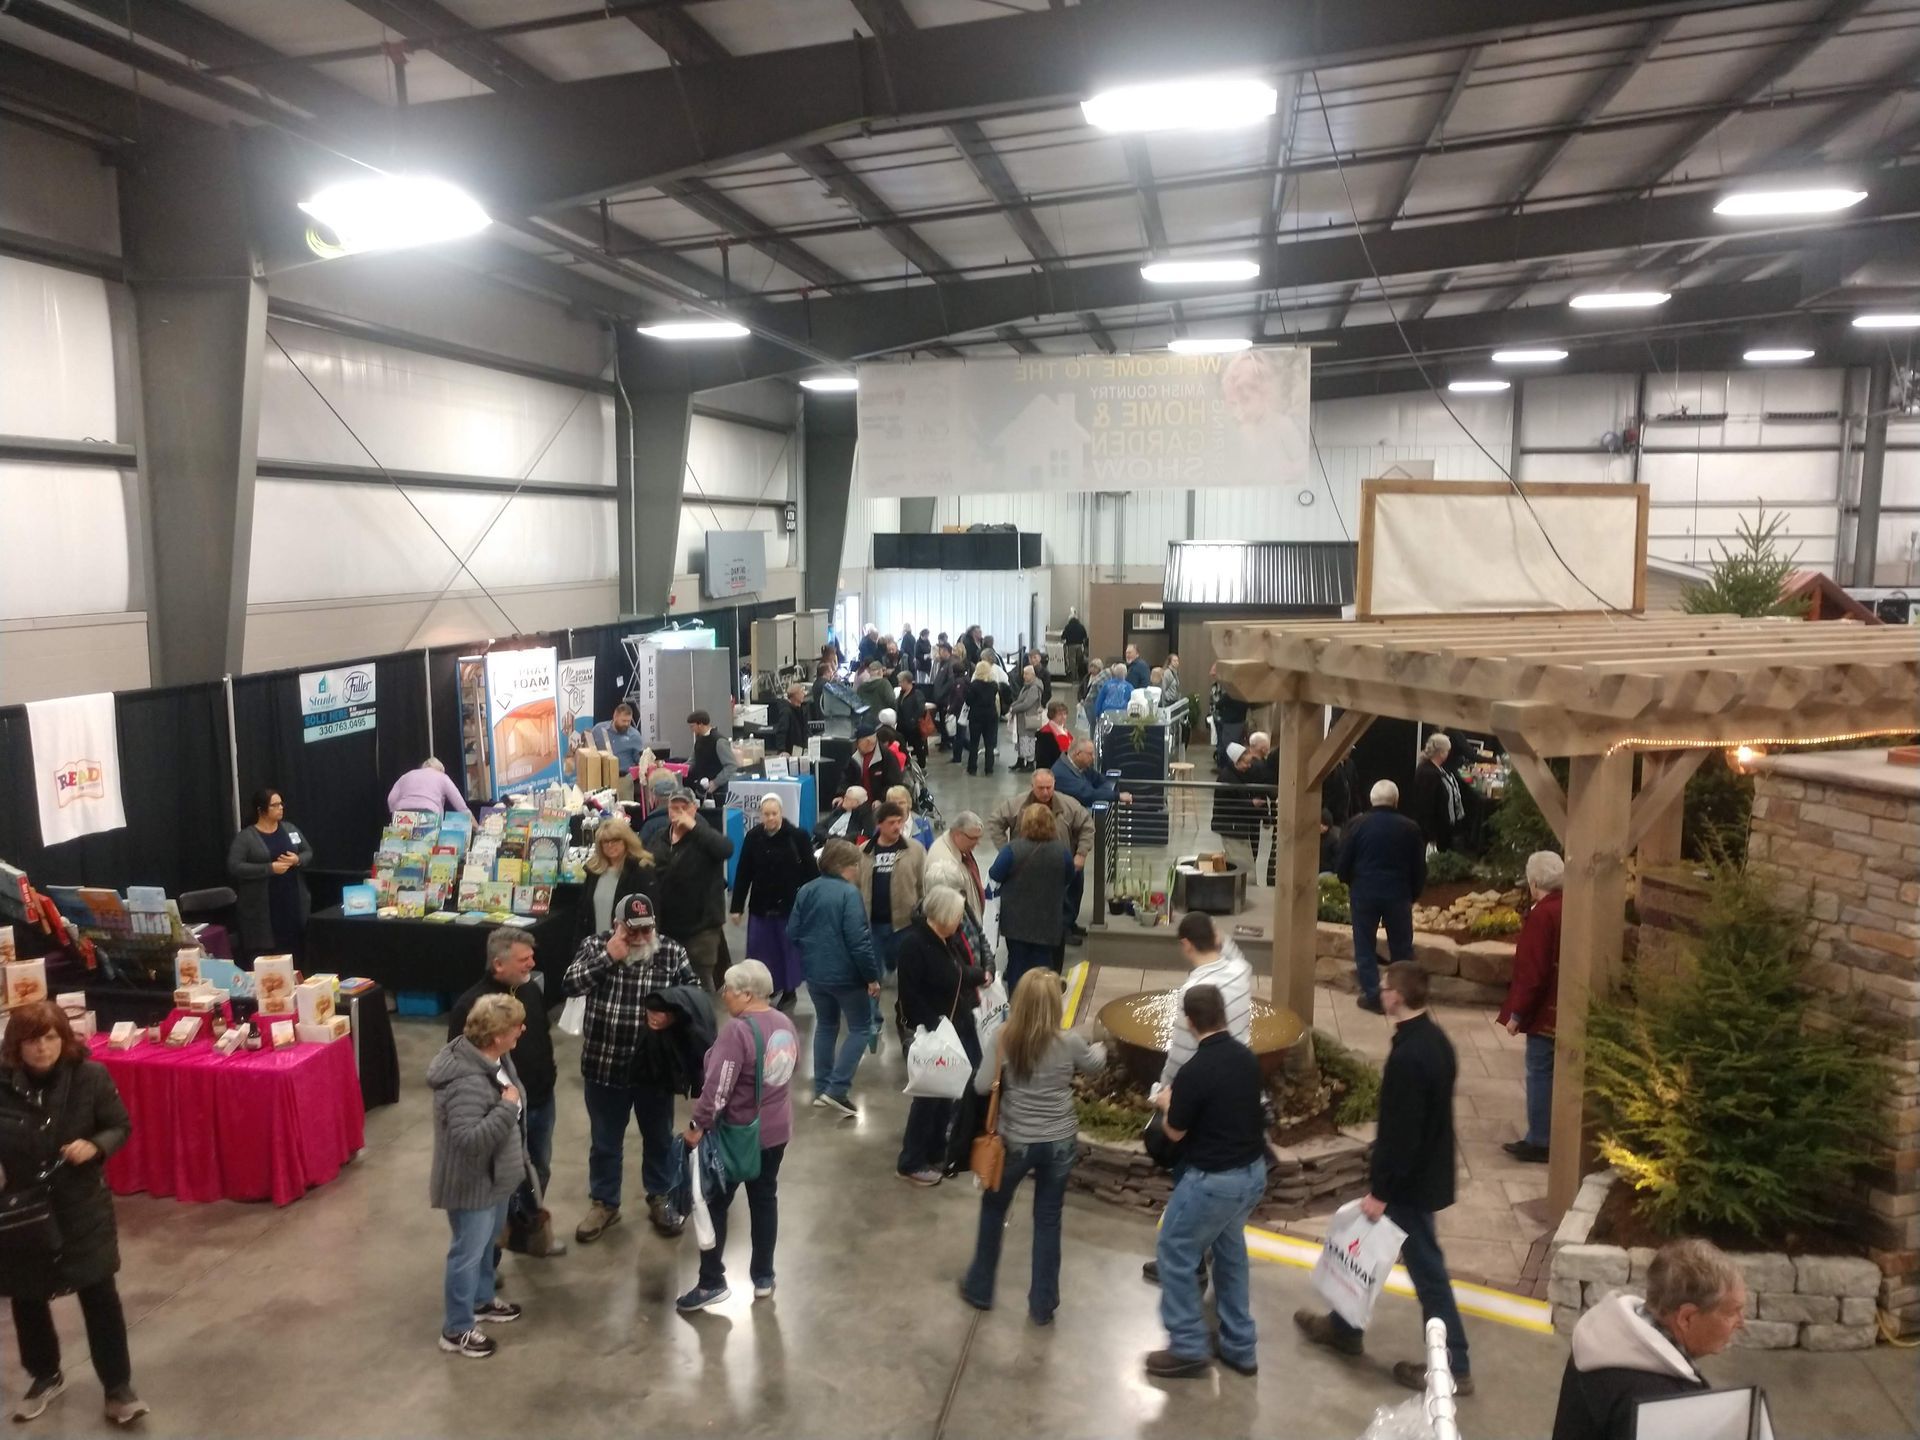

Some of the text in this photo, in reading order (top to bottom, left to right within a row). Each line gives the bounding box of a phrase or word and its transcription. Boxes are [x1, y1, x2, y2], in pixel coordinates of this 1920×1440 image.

[346, 674, 373, 704] Fuller
[576, 674, 593, 683] FOAM
[319, 718, 367, 736] 330.763.0495
[57, 767, 100, 791] READ
